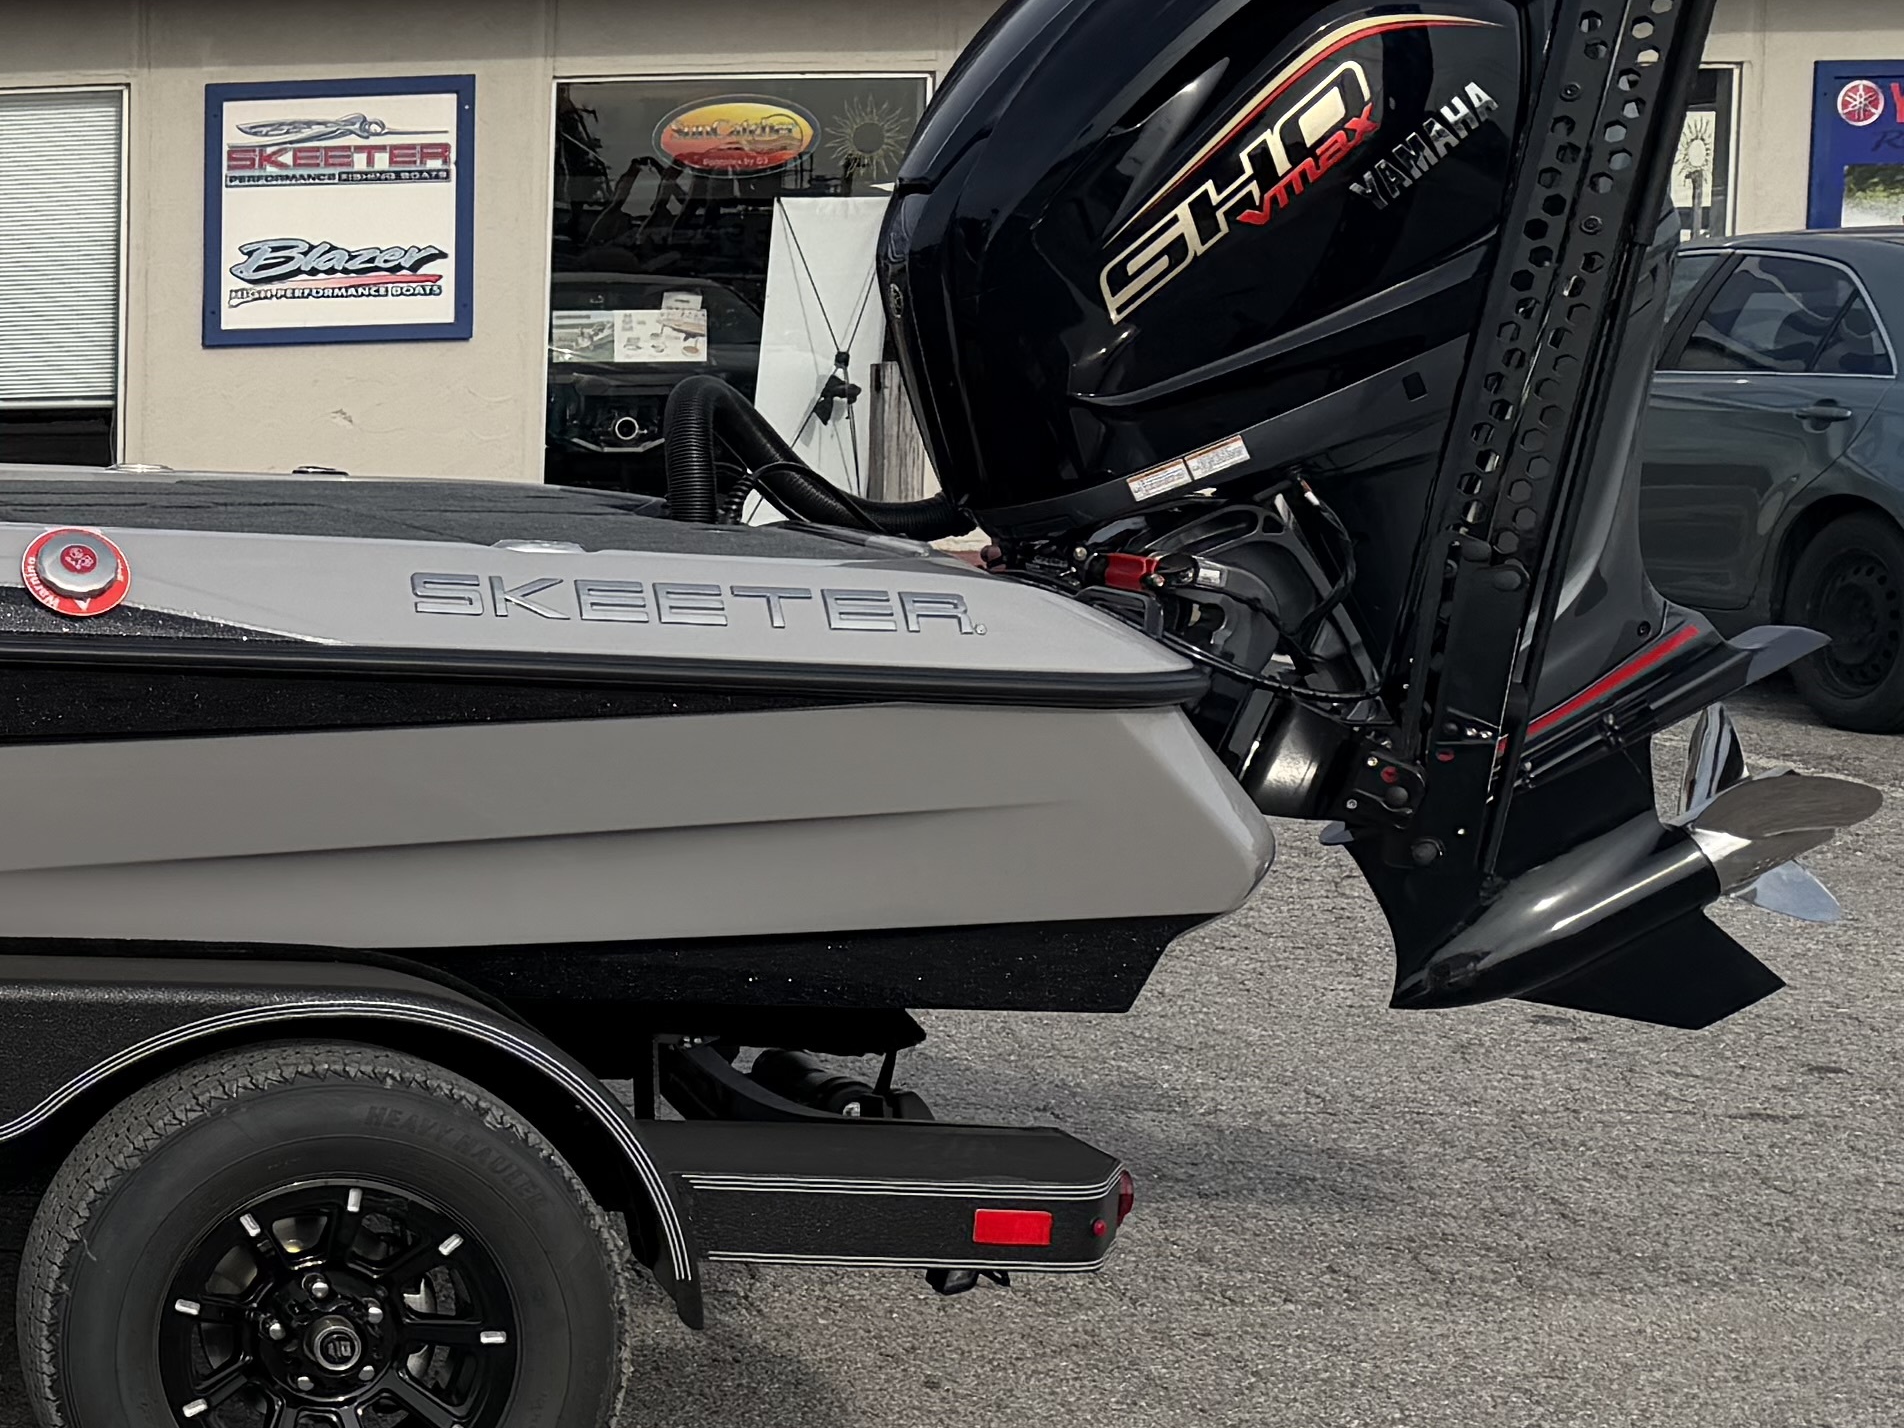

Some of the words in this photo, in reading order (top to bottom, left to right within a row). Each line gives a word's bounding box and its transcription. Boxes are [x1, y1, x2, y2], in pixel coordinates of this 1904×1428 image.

[227, 142, 452, 172] SKEETER
[1348, 80, 1500, 212] YAMAHA
[229, 173, 337, 185] PERFORMANCE
[341, 173, 396, 183] FISHING
[400, 171, 449, 181] BOATS
[1099, 59, 1373, 326] SHO
[229, 238, 449, 286] Blazer
[275, 285, 389, 300] PERFORMANCE
[391, 283, 443, 299] BOATS
[410, 571, 976, 636] SKEETER
